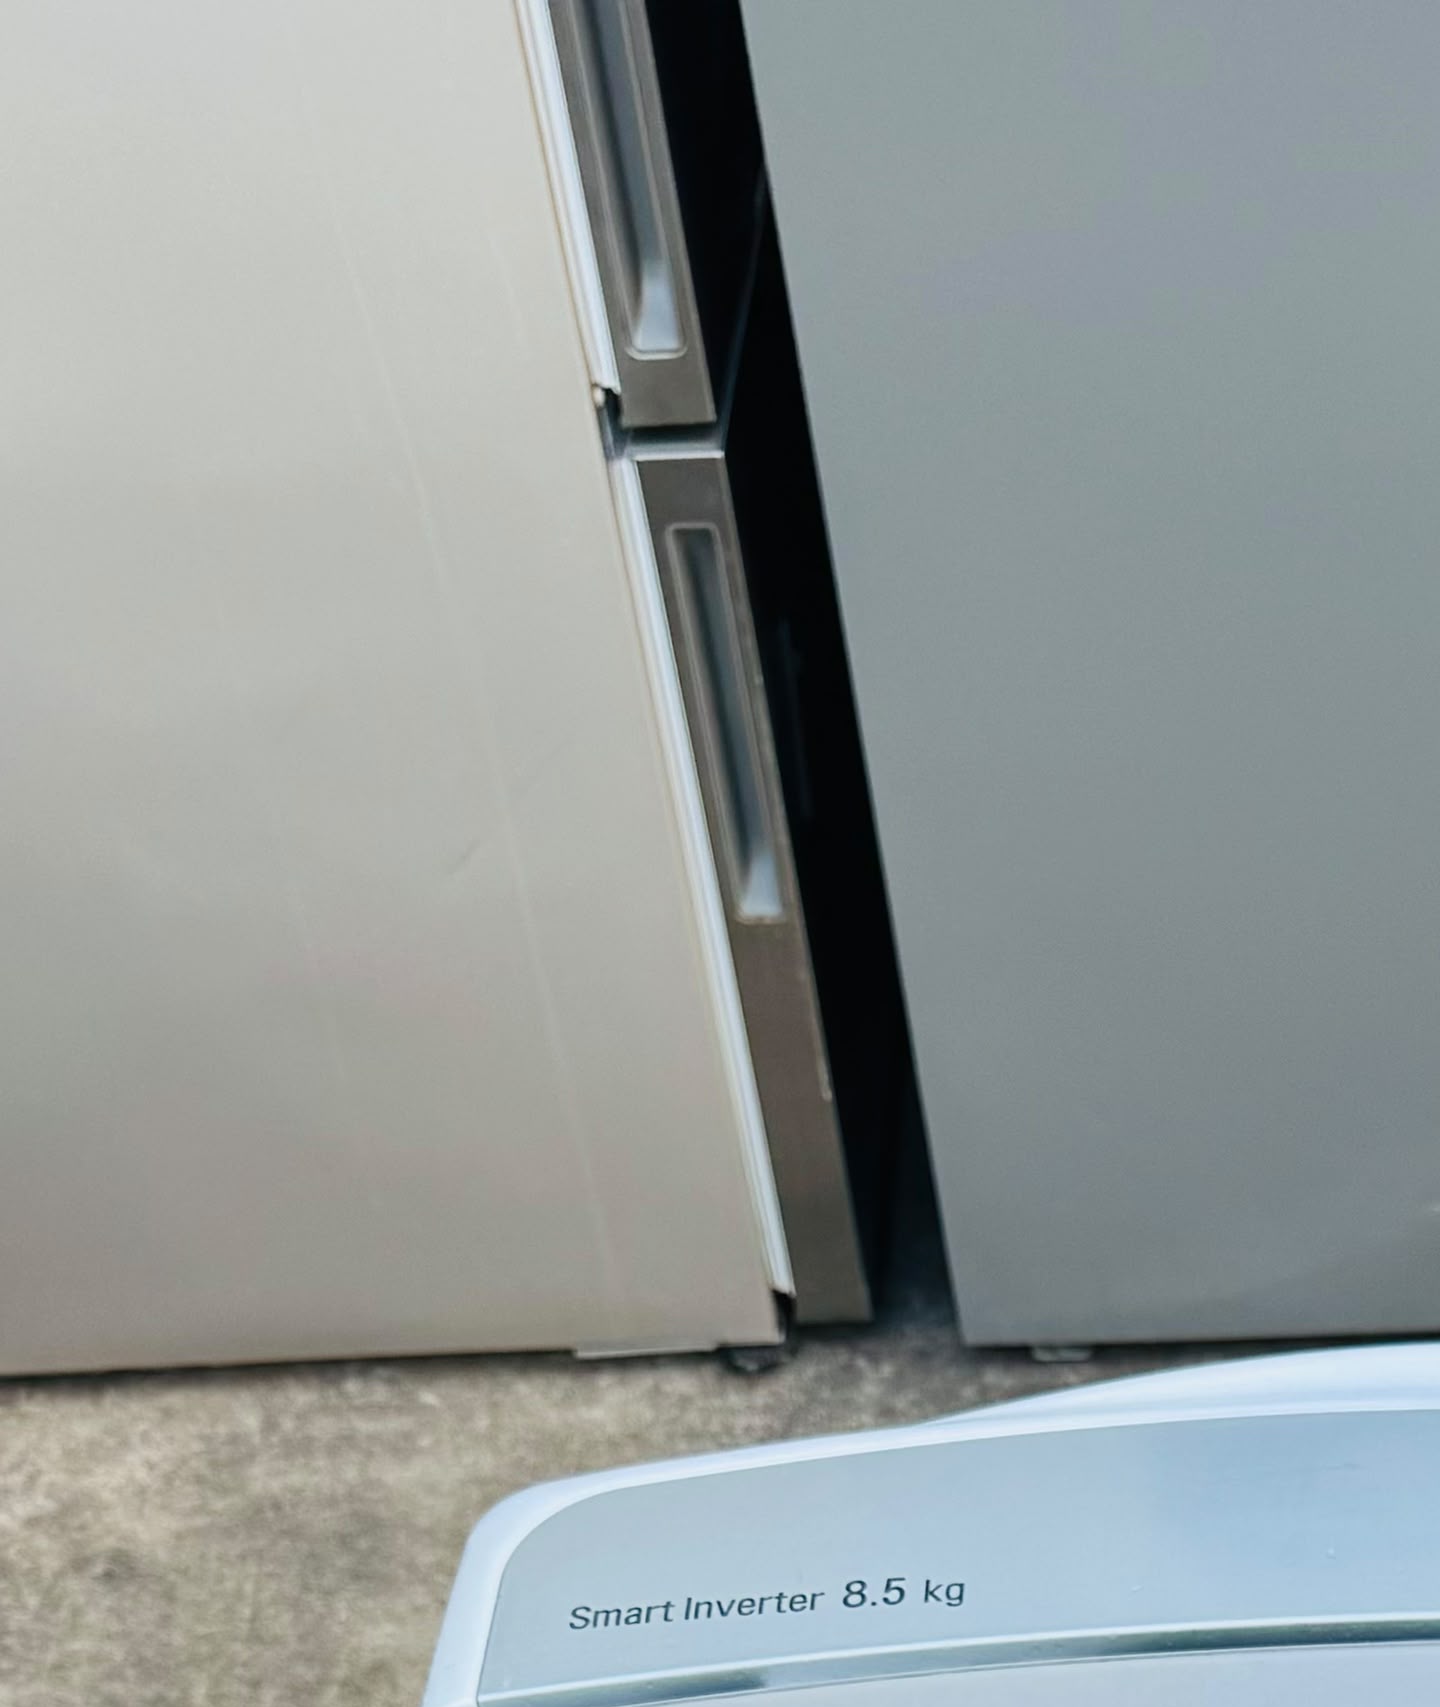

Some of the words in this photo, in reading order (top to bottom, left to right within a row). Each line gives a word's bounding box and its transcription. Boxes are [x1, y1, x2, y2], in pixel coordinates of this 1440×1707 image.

[569, 1601, 674, 1630] Smart
[684, 1589, 825, 1621] Inverter
[842, 1578, 906, 1609] 8.5
[924, 1578, 965, 1608] kg
